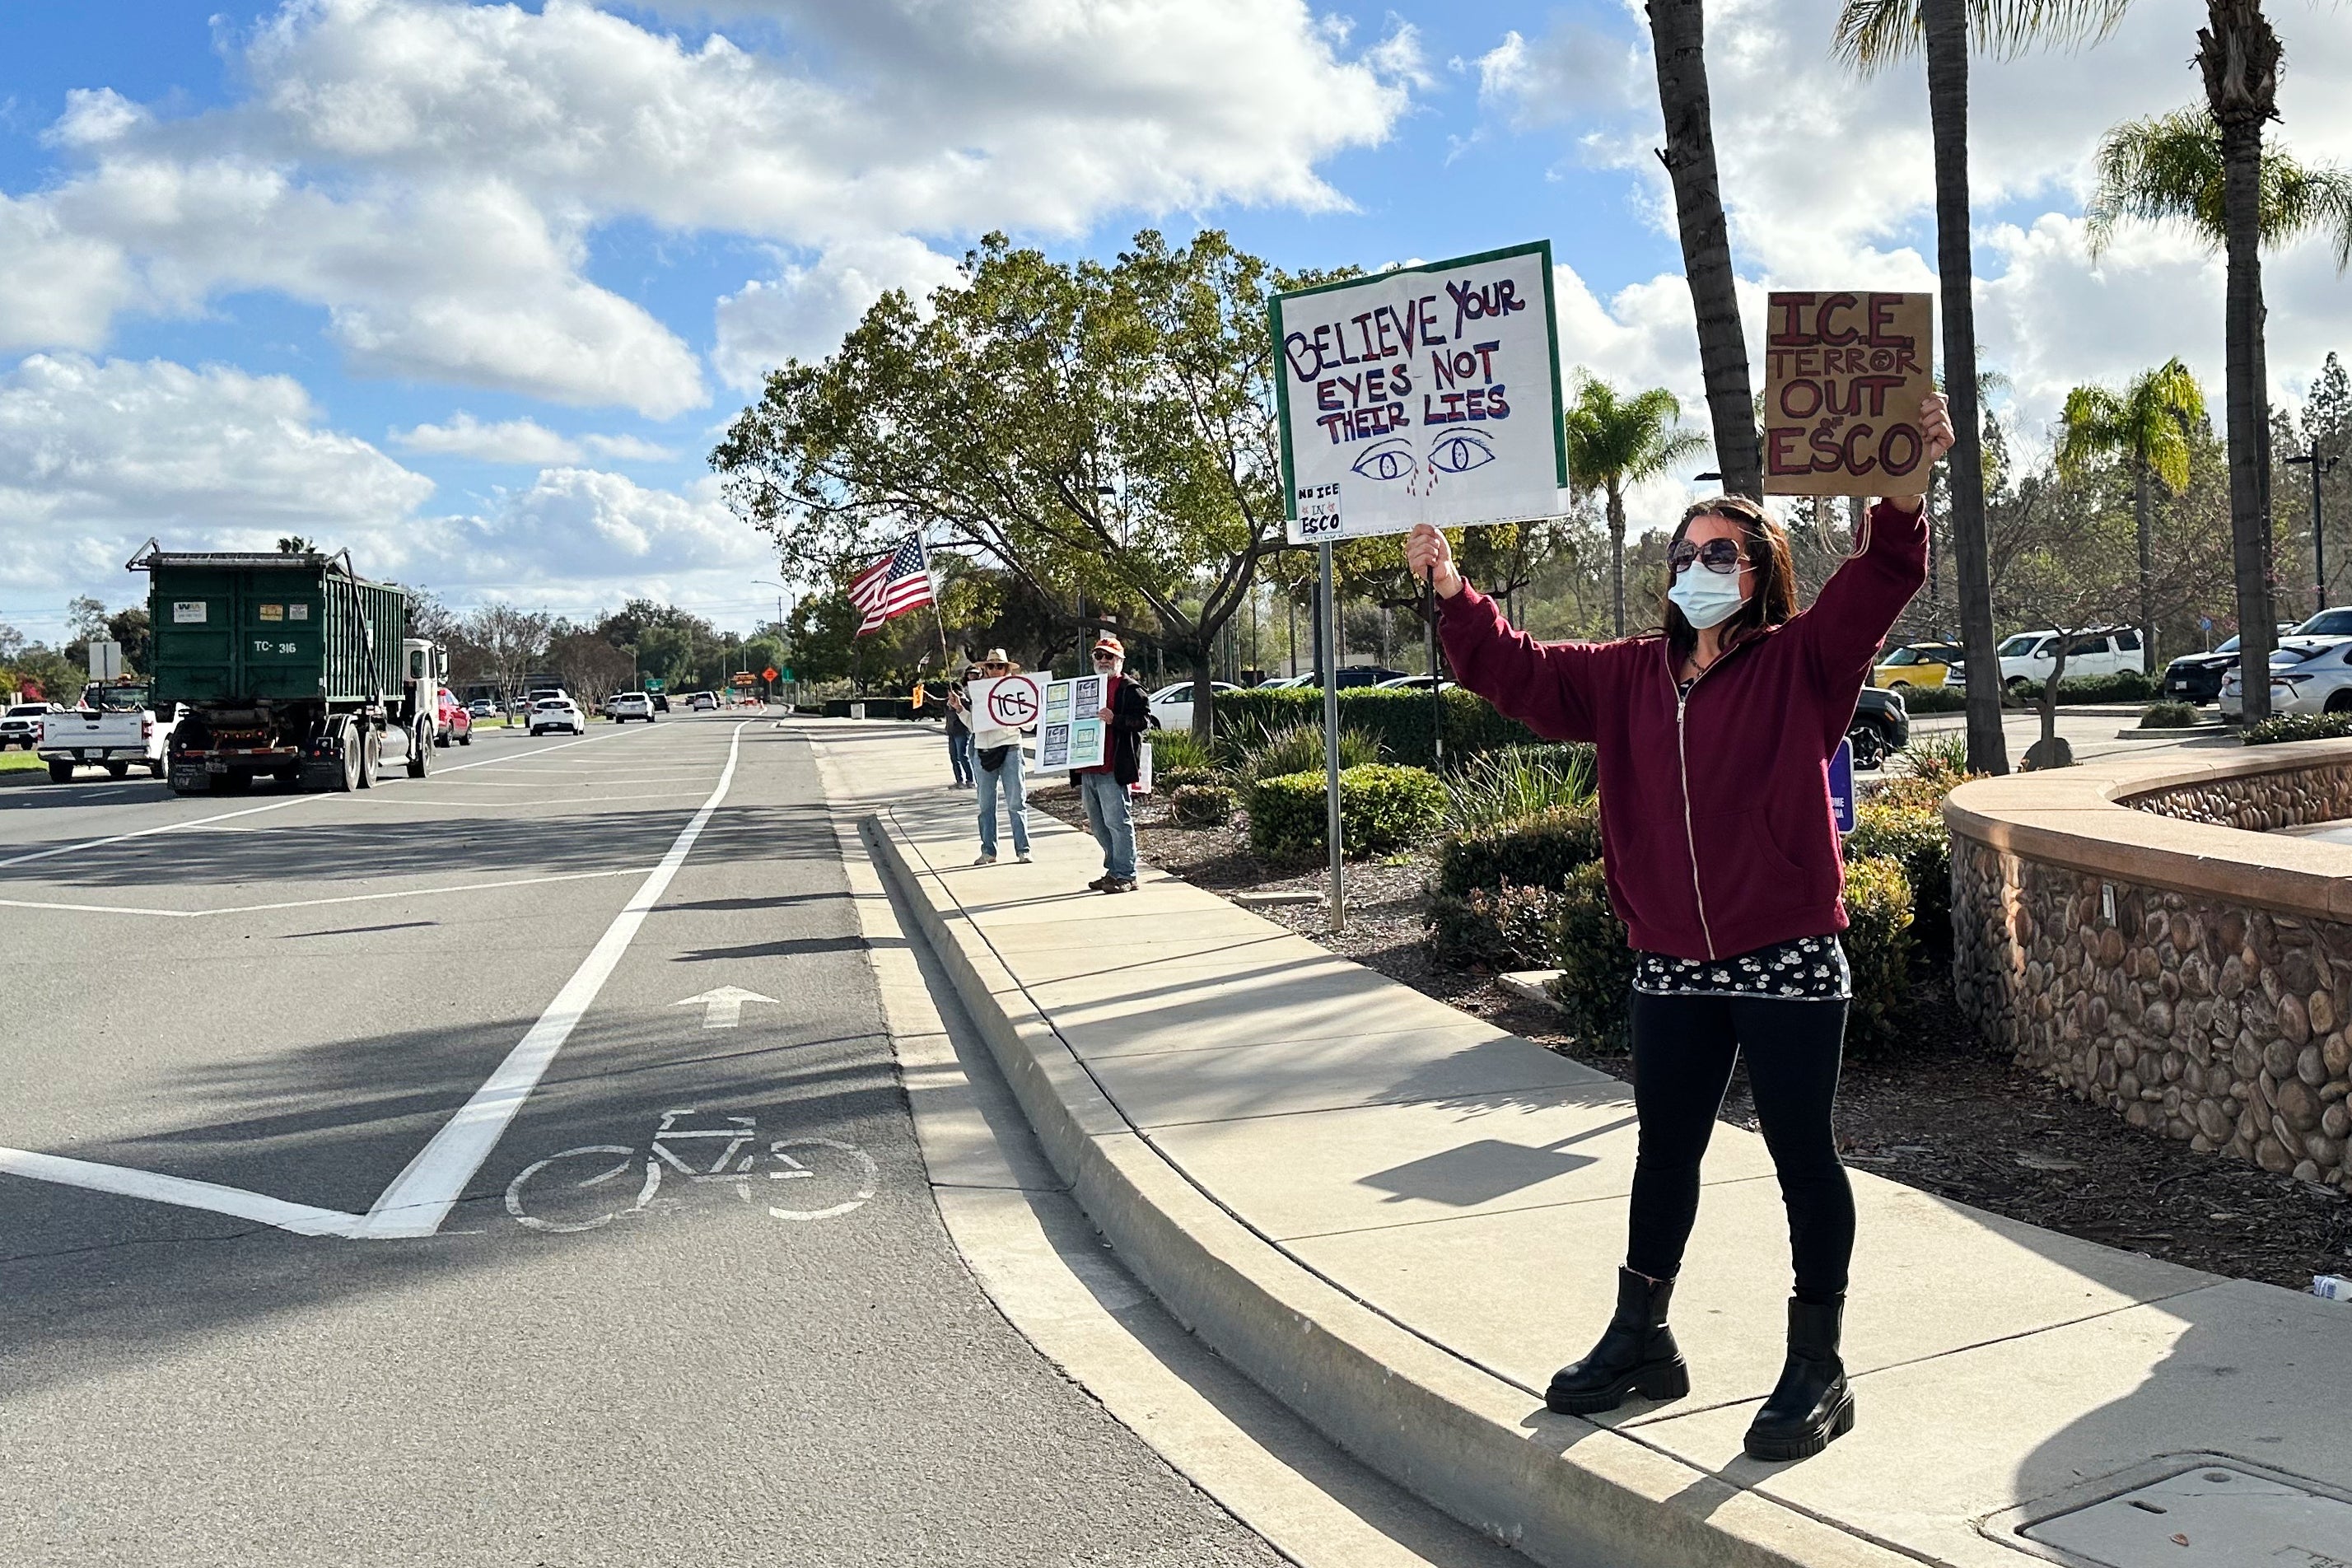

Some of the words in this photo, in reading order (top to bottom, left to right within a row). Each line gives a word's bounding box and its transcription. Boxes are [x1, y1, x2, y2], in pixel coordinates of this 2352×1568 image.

[1285, 296, 1446, 382] BELIEVE
[1445, 278, 1525, 339] YOUR
[1767, 348, 1923, 379] TERROR
[1317, 363, 1412, 411] EYES
[1432, 340, 1500, 391] NOT
[1780, 375, 1907, 419] OUT
[1317, 401, 1410, 445] THEIR
[1423, 384, 1510, 426] LIES
[1820, 416, 1845, 430] OF
[1767, 422, 1924, 477] ESCO
[1299, 488, 1313, 499] NO
[1317, 483, 1339, 498] ICE
[1312, 504, 1325, 516] IN
[1300, 514, 1339, 534] ESCO
[278, 643, 296, 653] 316
[1079, 682, 1097, 691] ICE
[996, 691, 1028, 716] ICE
[1048, 728, 1066, 737] ICE
